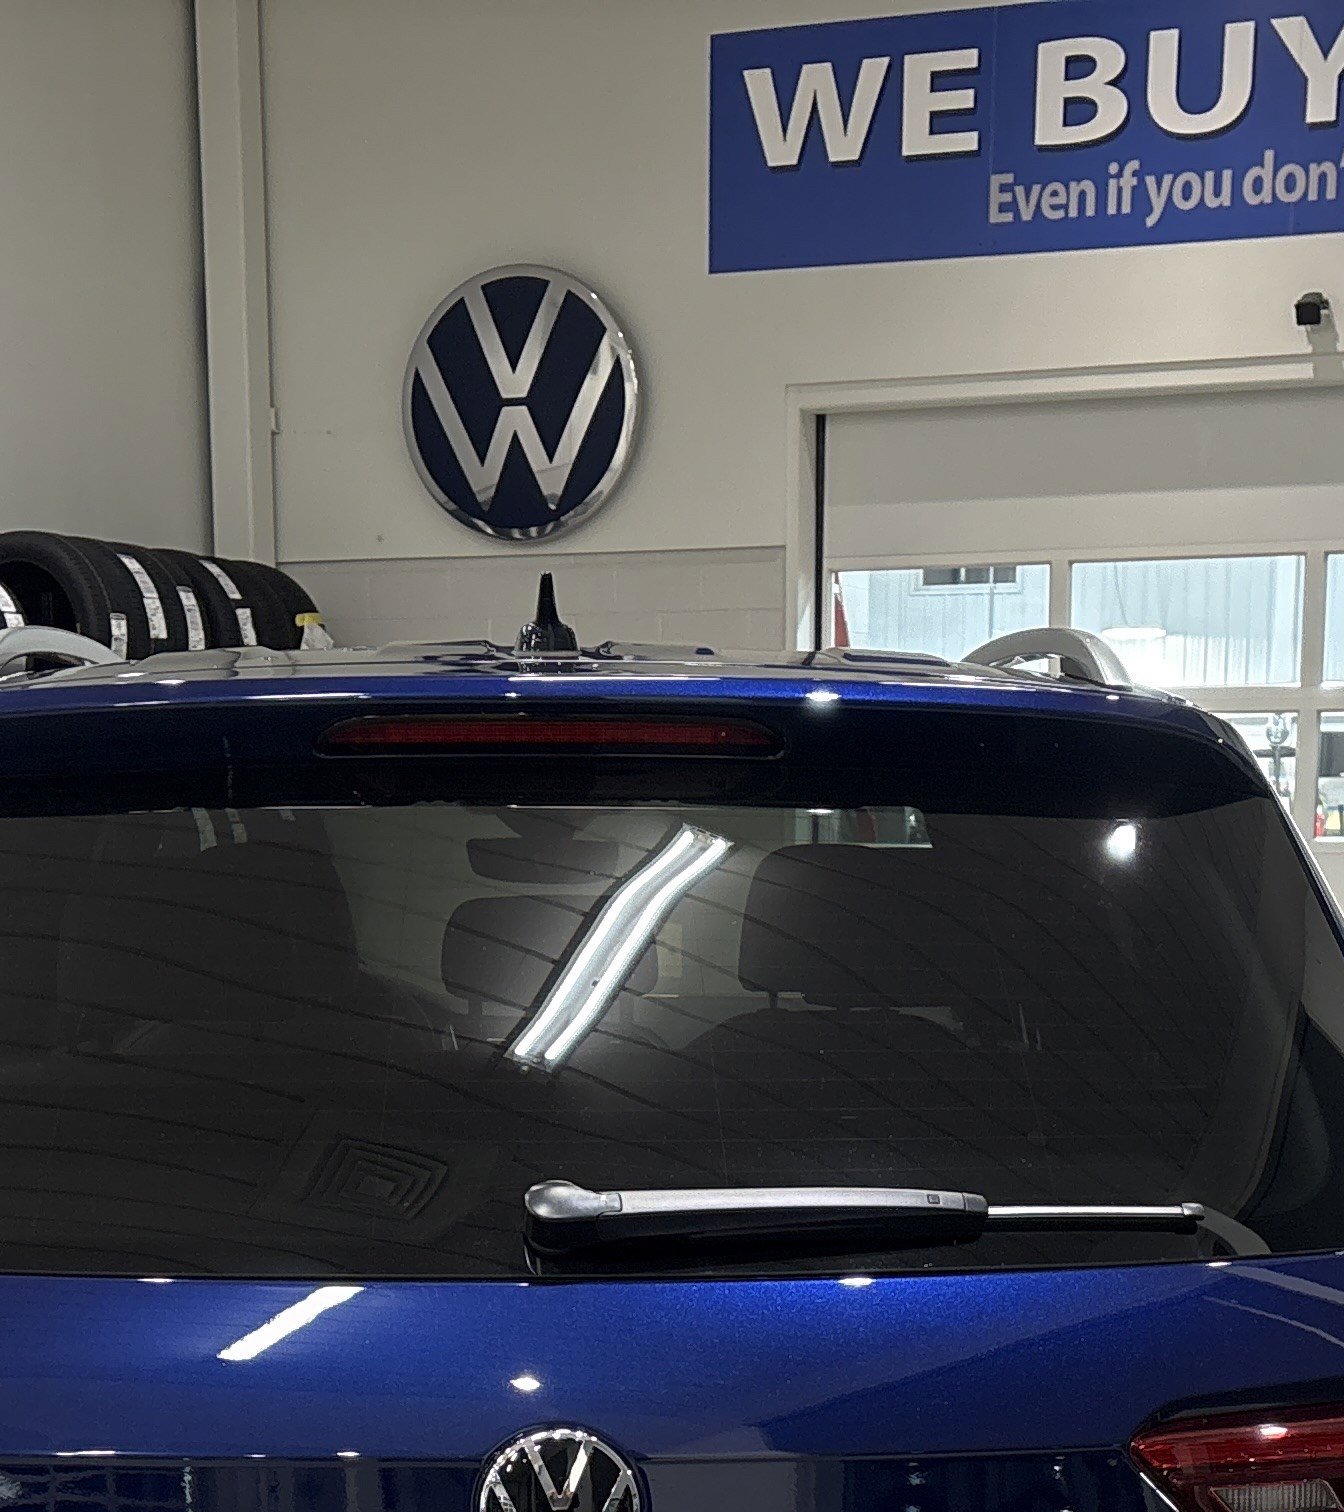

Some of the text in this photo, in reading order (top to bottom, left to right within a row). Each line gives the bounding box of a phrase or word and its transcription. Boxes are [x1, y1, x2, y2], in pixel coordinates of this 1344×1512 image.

[742, 47, 981, 169] WE
[988, 172, 1096, 225] Even
[1106, 159, 1141, 216] if
[1146, 166, 1232, 228] you
